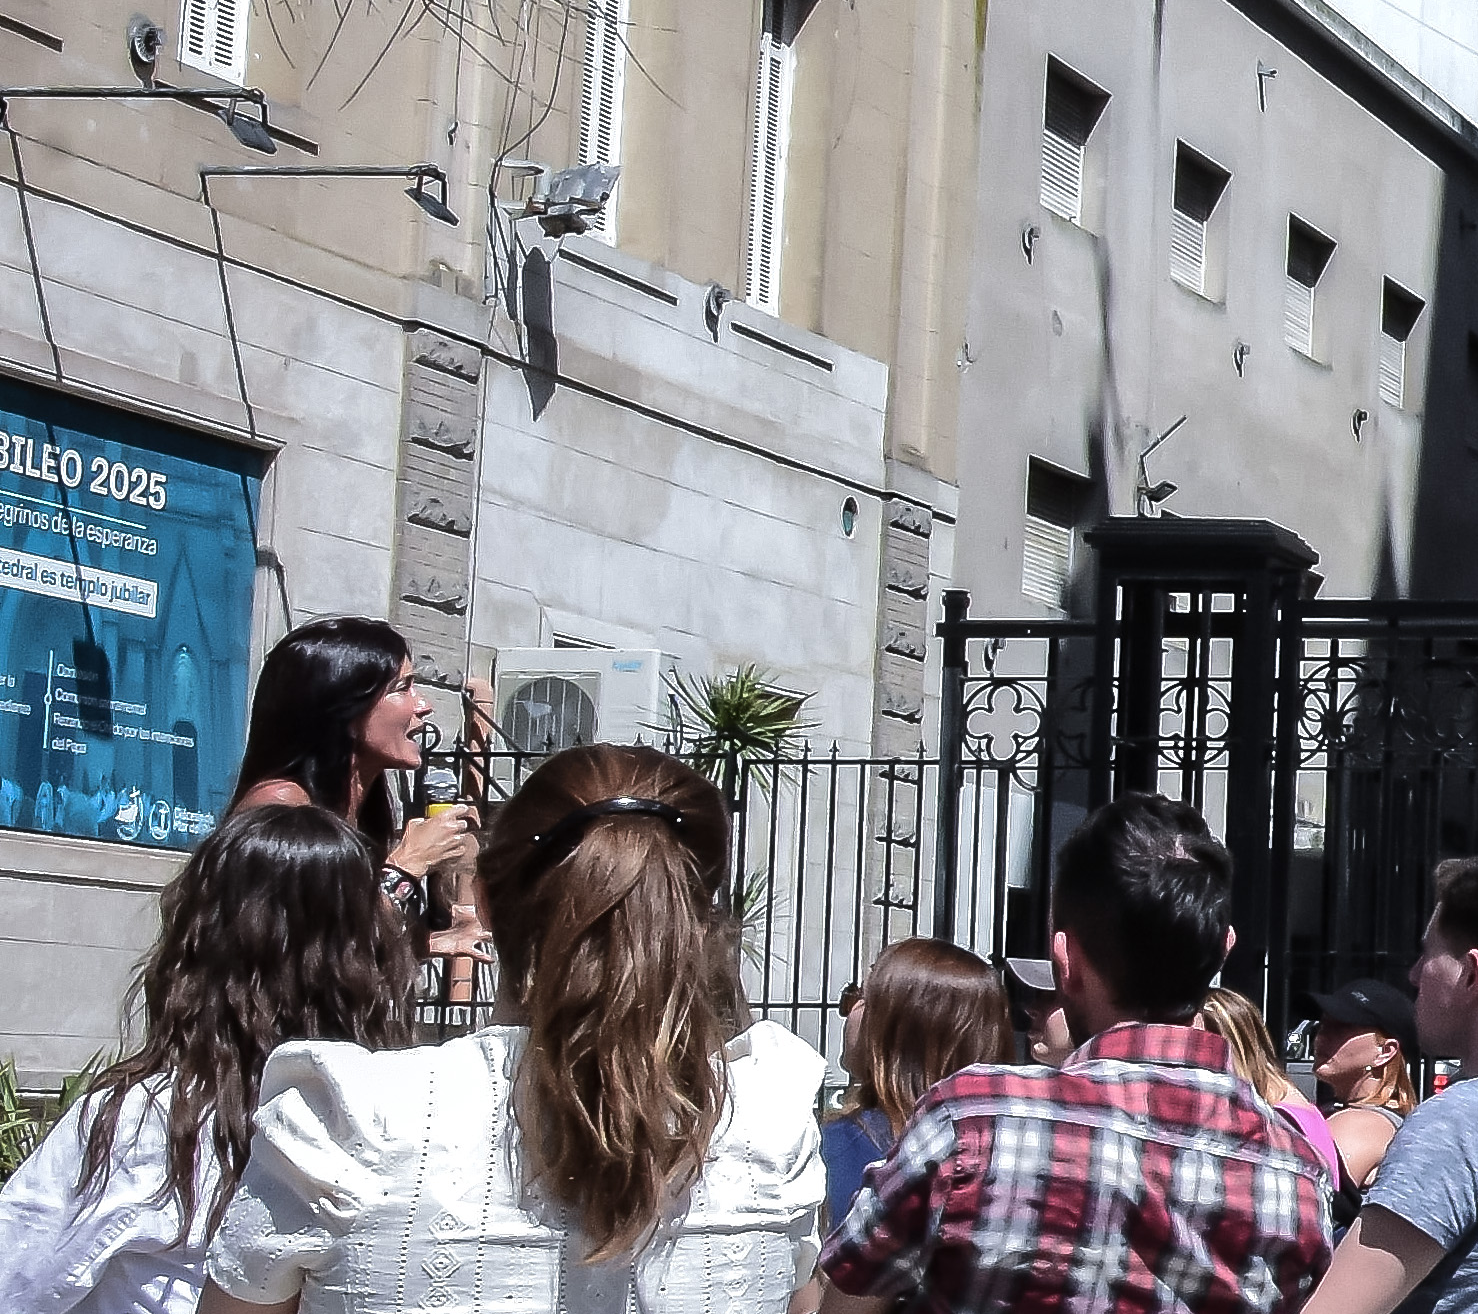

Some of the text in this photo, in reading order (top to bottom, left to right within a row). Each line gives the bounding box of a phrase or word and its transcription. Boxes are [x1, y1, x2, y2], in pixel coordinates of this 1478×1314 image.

[90, 456, 167, 510] 2025
[51, 512, 69, 535] de
[72, 516, 85, 538] la
[86, 523, 158, 556] esperanza
[41, 569, 57, 586] es
[60, 571, 108, 597] templo
[108, 580, 151, 605] jubilar
